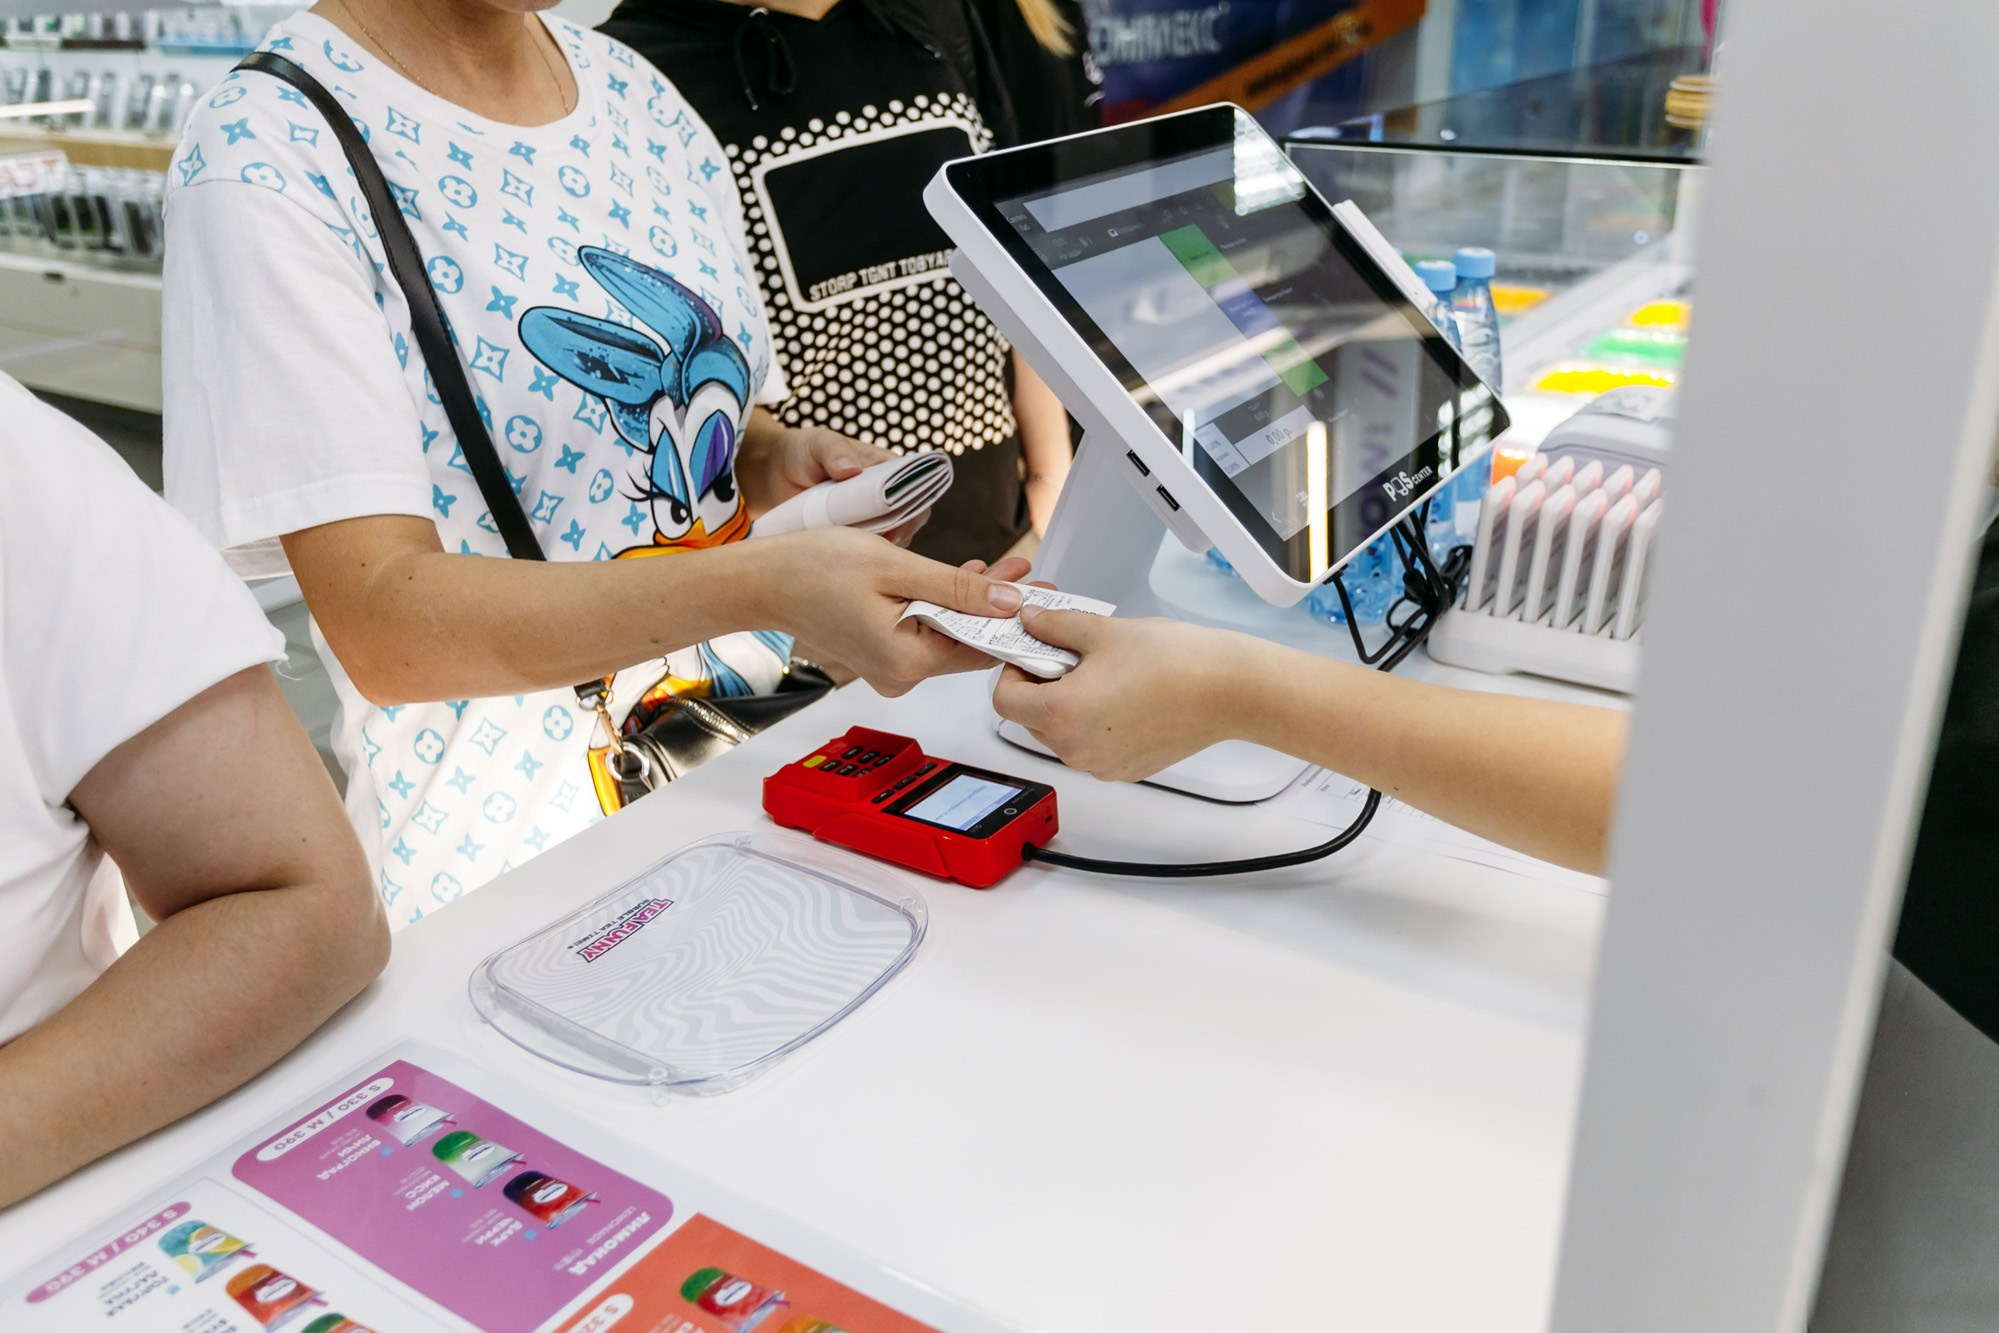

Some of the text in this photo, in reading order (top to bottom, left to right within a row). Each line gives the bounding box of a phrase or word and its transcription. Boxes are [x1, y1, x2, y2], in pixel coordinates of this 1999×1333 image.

[1382, 471, 1414, 502] POS
[599, 920, 618, 931] TEA
[369, 1084, 381, 1092] S
[338, 1092, 368, 1111] 330
[307, 1119, 325, 1130] M
[274, 1131, 306, 1151] 390
[337, 1134, 372, 1158] ЛИЧИ
[316, 1139, 382, 1180] ВИНОГРАД
[405, 1174, 441, 1199] КИСС
[406, 1180, 450, 1211] МЕЛОН
[124, 1219, 161, 1244] 340
[568, 1211, 651, 1276] ЛИМОНАД
[45, 1266, 86, 1291] 390
[577, 1303, 619, 1333] S 32
